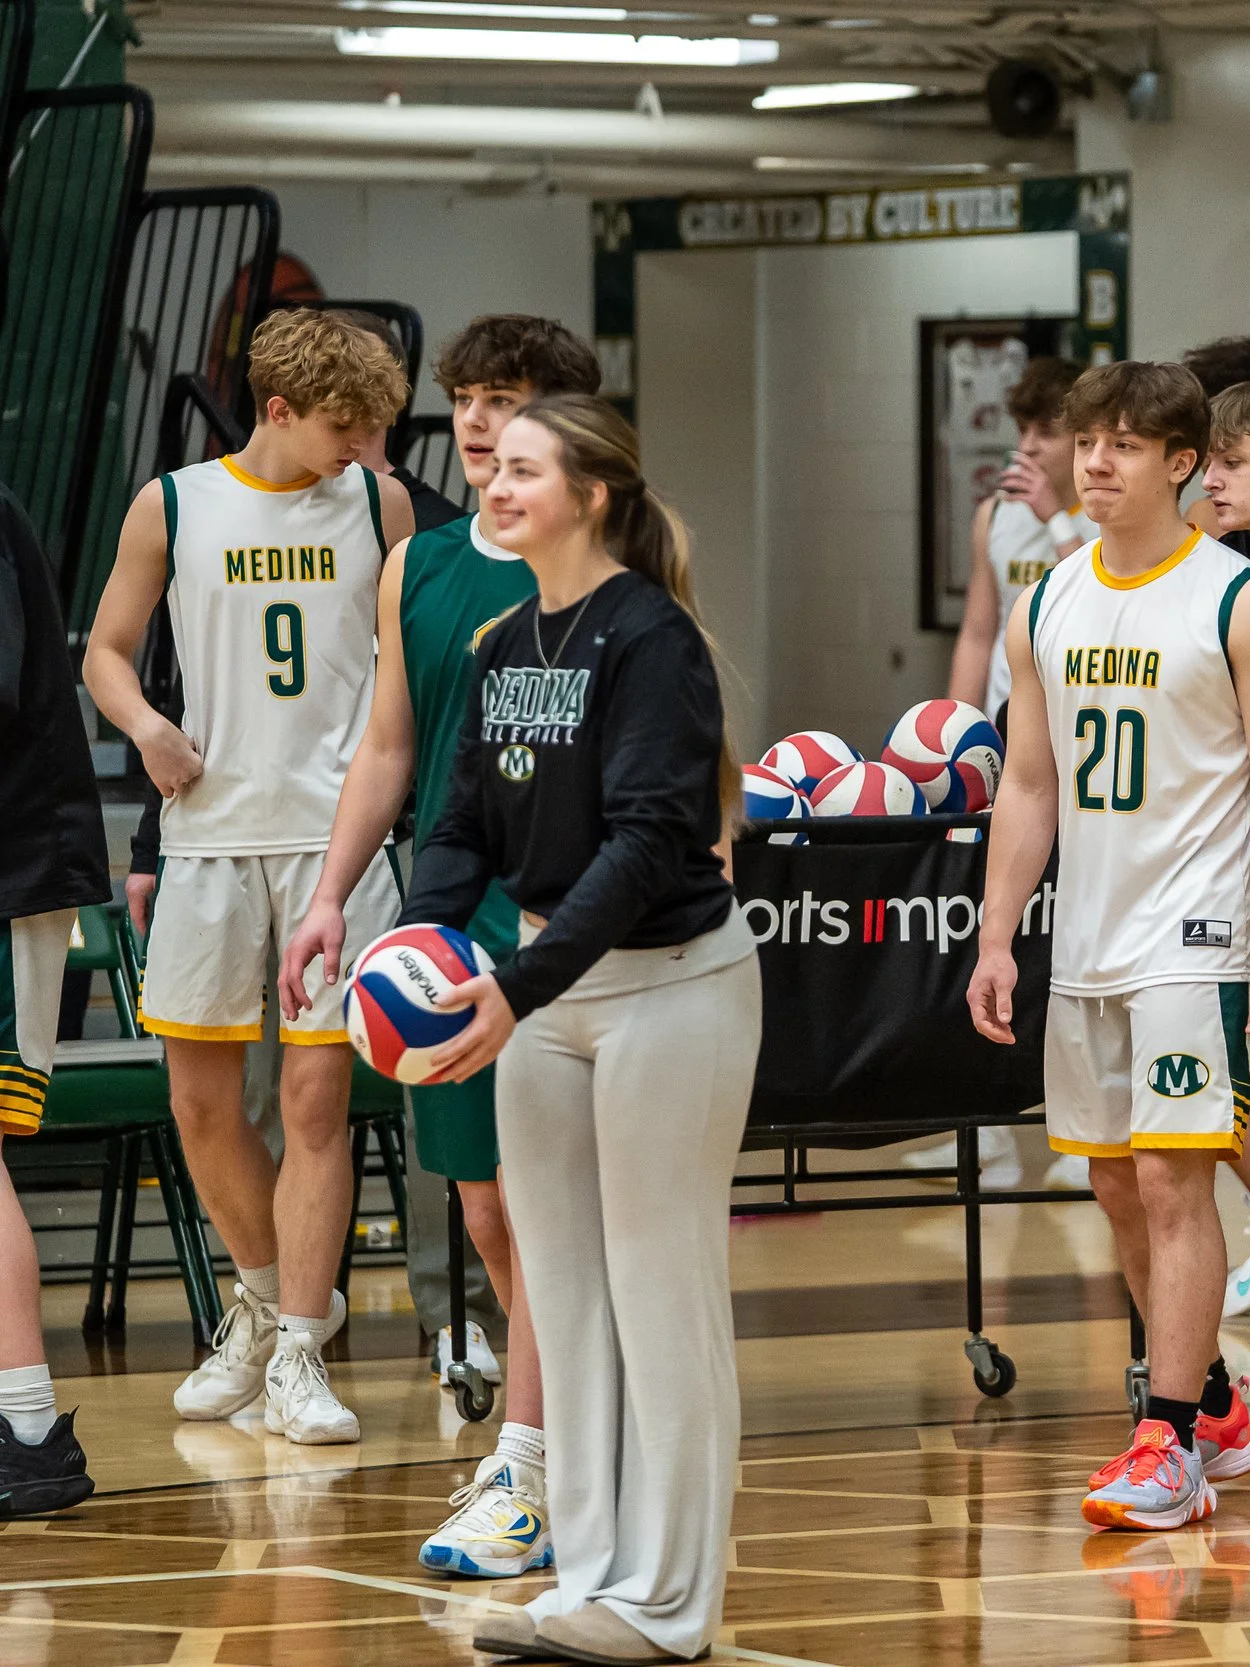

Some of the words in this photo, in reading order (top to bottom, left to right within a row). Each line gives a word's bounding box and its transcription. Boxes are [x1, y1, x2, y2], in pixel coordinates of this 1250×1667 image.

[679, 197, 824, 247] CREATED
[825, 192, 870, 242] BY
[872, 184, 1020, 236] CULTURE
[224, 545, 337, 584] MEDINA
[262, 600, 308, 700] 9
[1065, 646, 1161, 688] MEDINA
[1074, 704, 1149, 814] 20
[740, 890, 850, 945] orts
[395, 950, 440, 1006] molten
[1150, 1055, 1206, 1097] M
